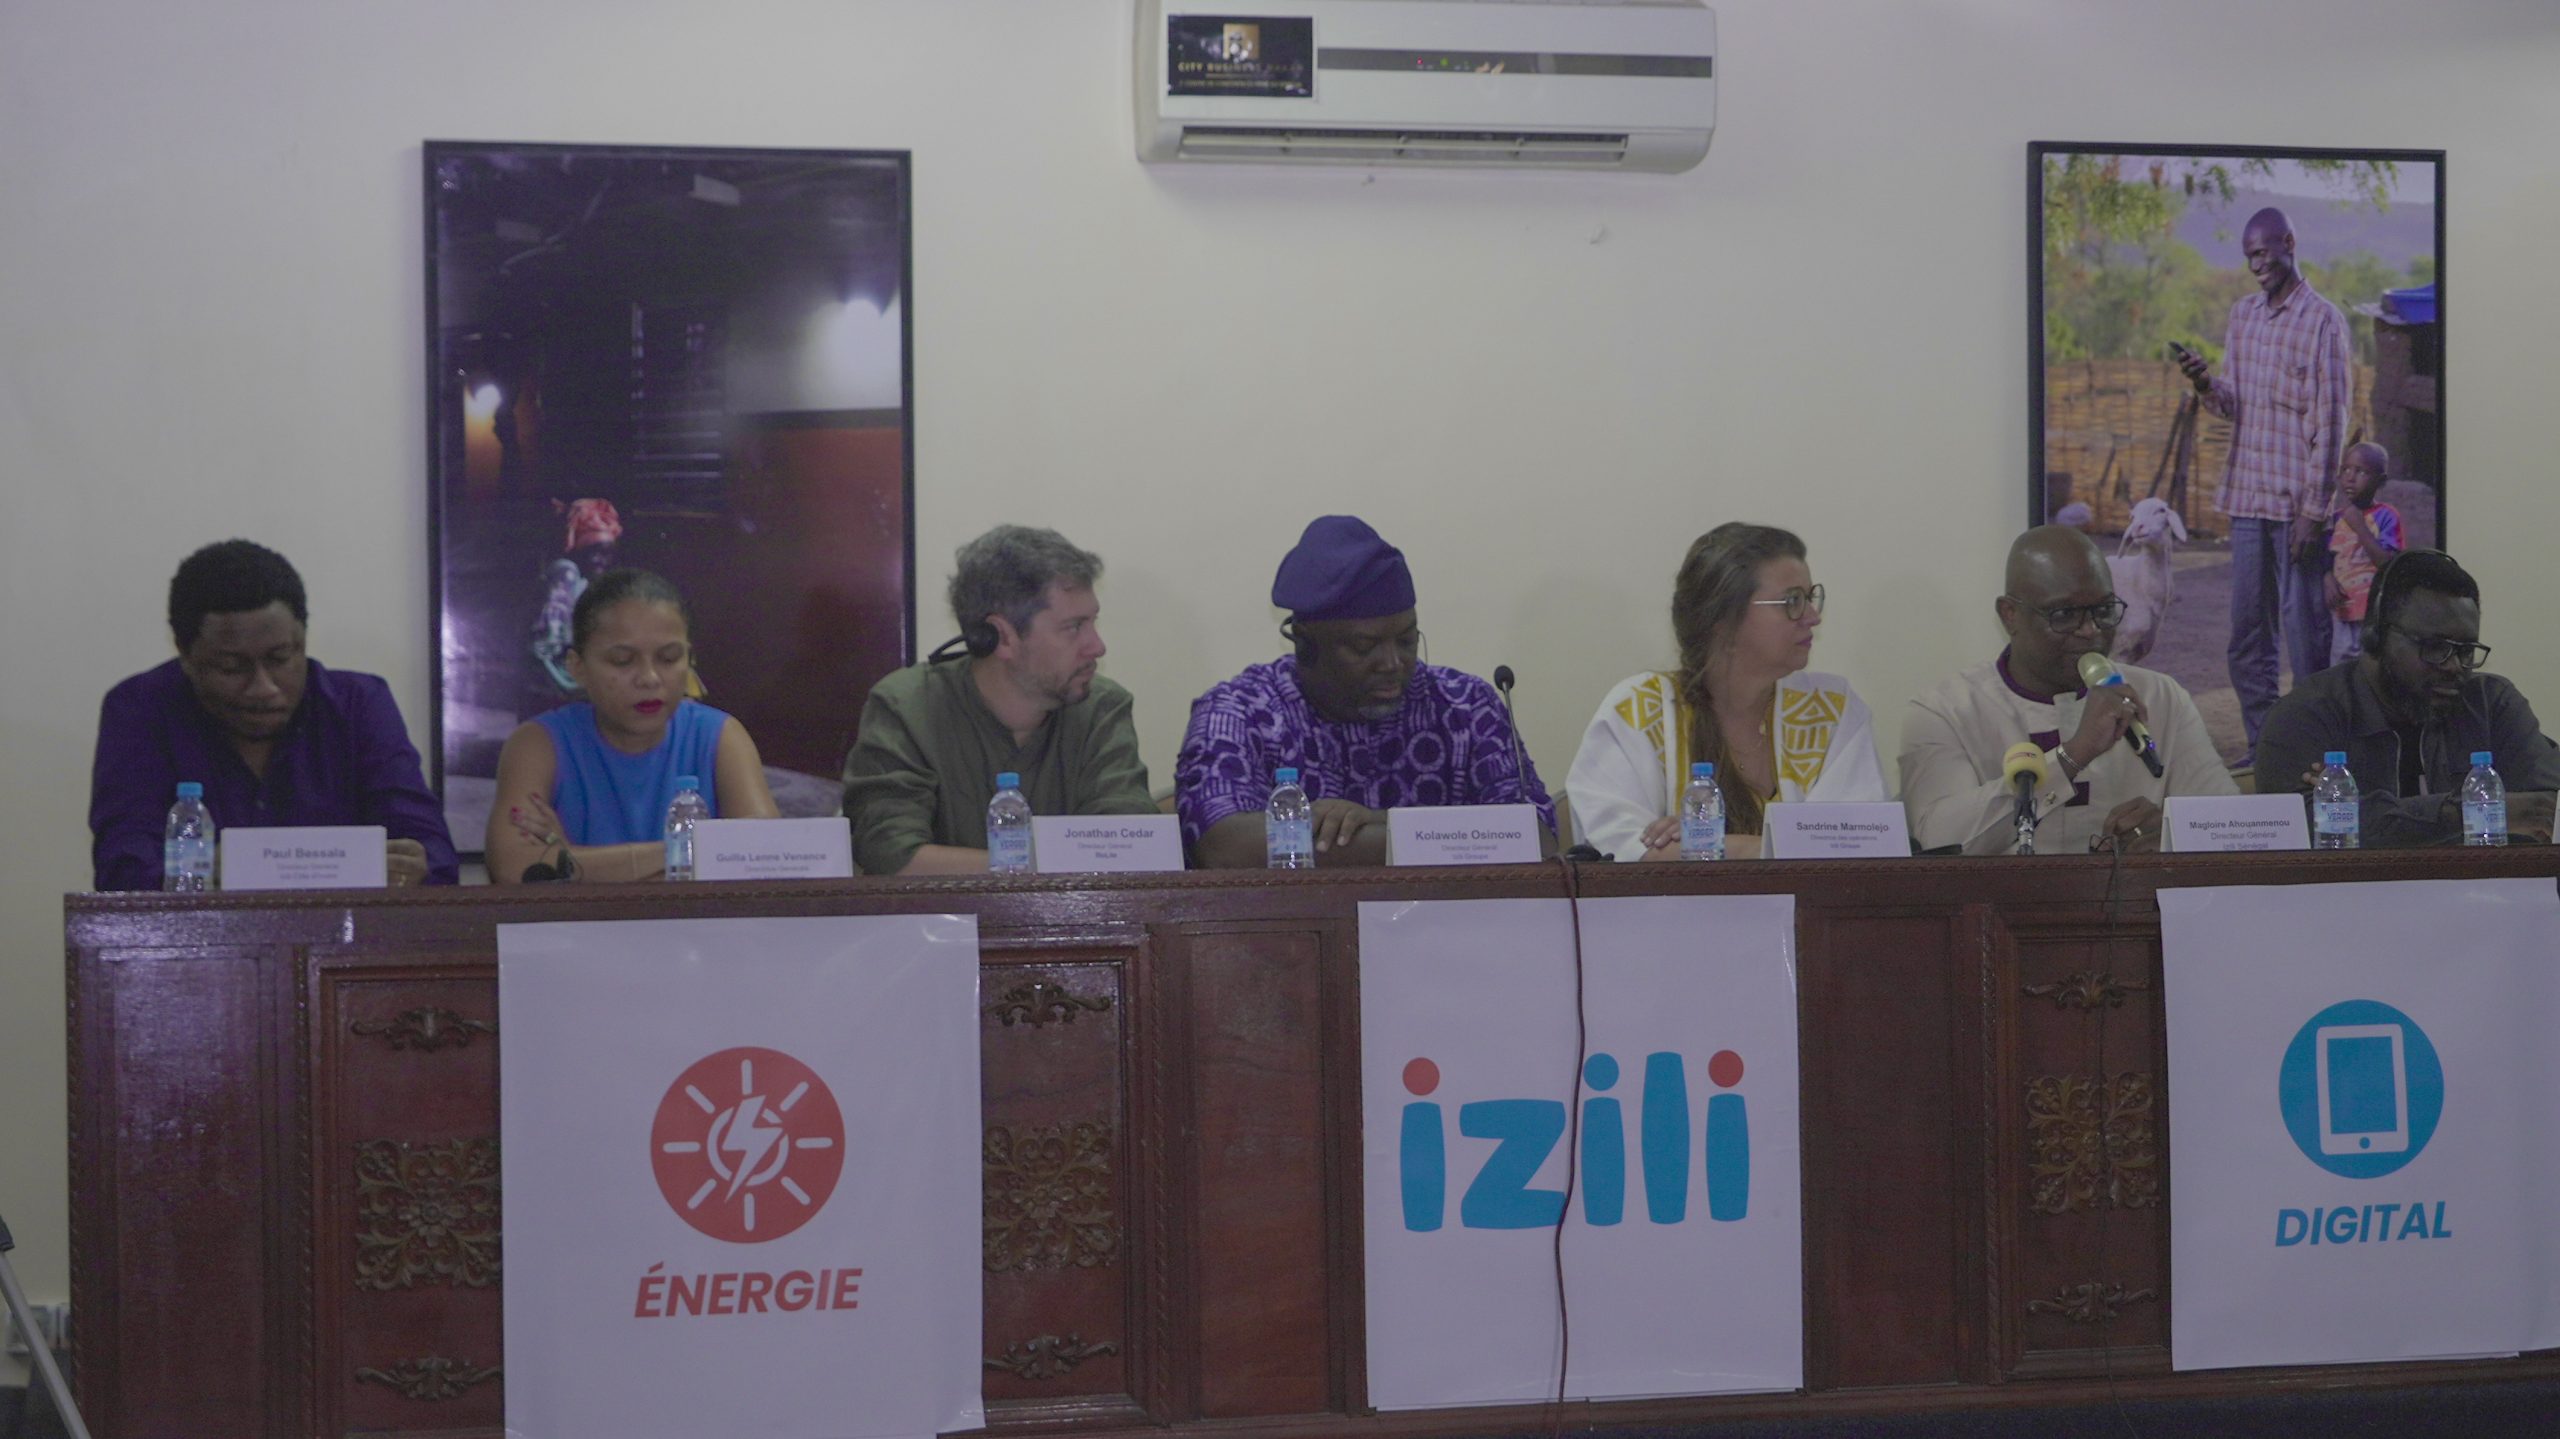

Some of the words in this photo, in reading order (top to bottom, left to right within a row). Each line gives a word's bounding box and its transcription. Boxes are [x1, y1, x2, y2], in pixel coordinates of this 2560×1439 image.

[1796, 822, 1838, 831] Sandrine
[1840, 822, 1889, 833] Marmolejo
[2189, 821, 2226, 830] Magloire
[2229, 819, 2290, 829] Ahouanmenou
[1065, 828, 1118, 838] Jonathan
[1120, 828, 1154, 838] Cedar
[1415, 831, 1468, 841] Kolawole
[1471, 830, 1522, 840] Osinowo
[263, 848, 291, 858] Paul
[783, 852, 827, 861] Venance
[1400, 1050, 1750, 1232] izili
[2275, 1201, 2453, 1247] DIGITAL
[634, 1261, 863, 1318] ÉNERGIE
